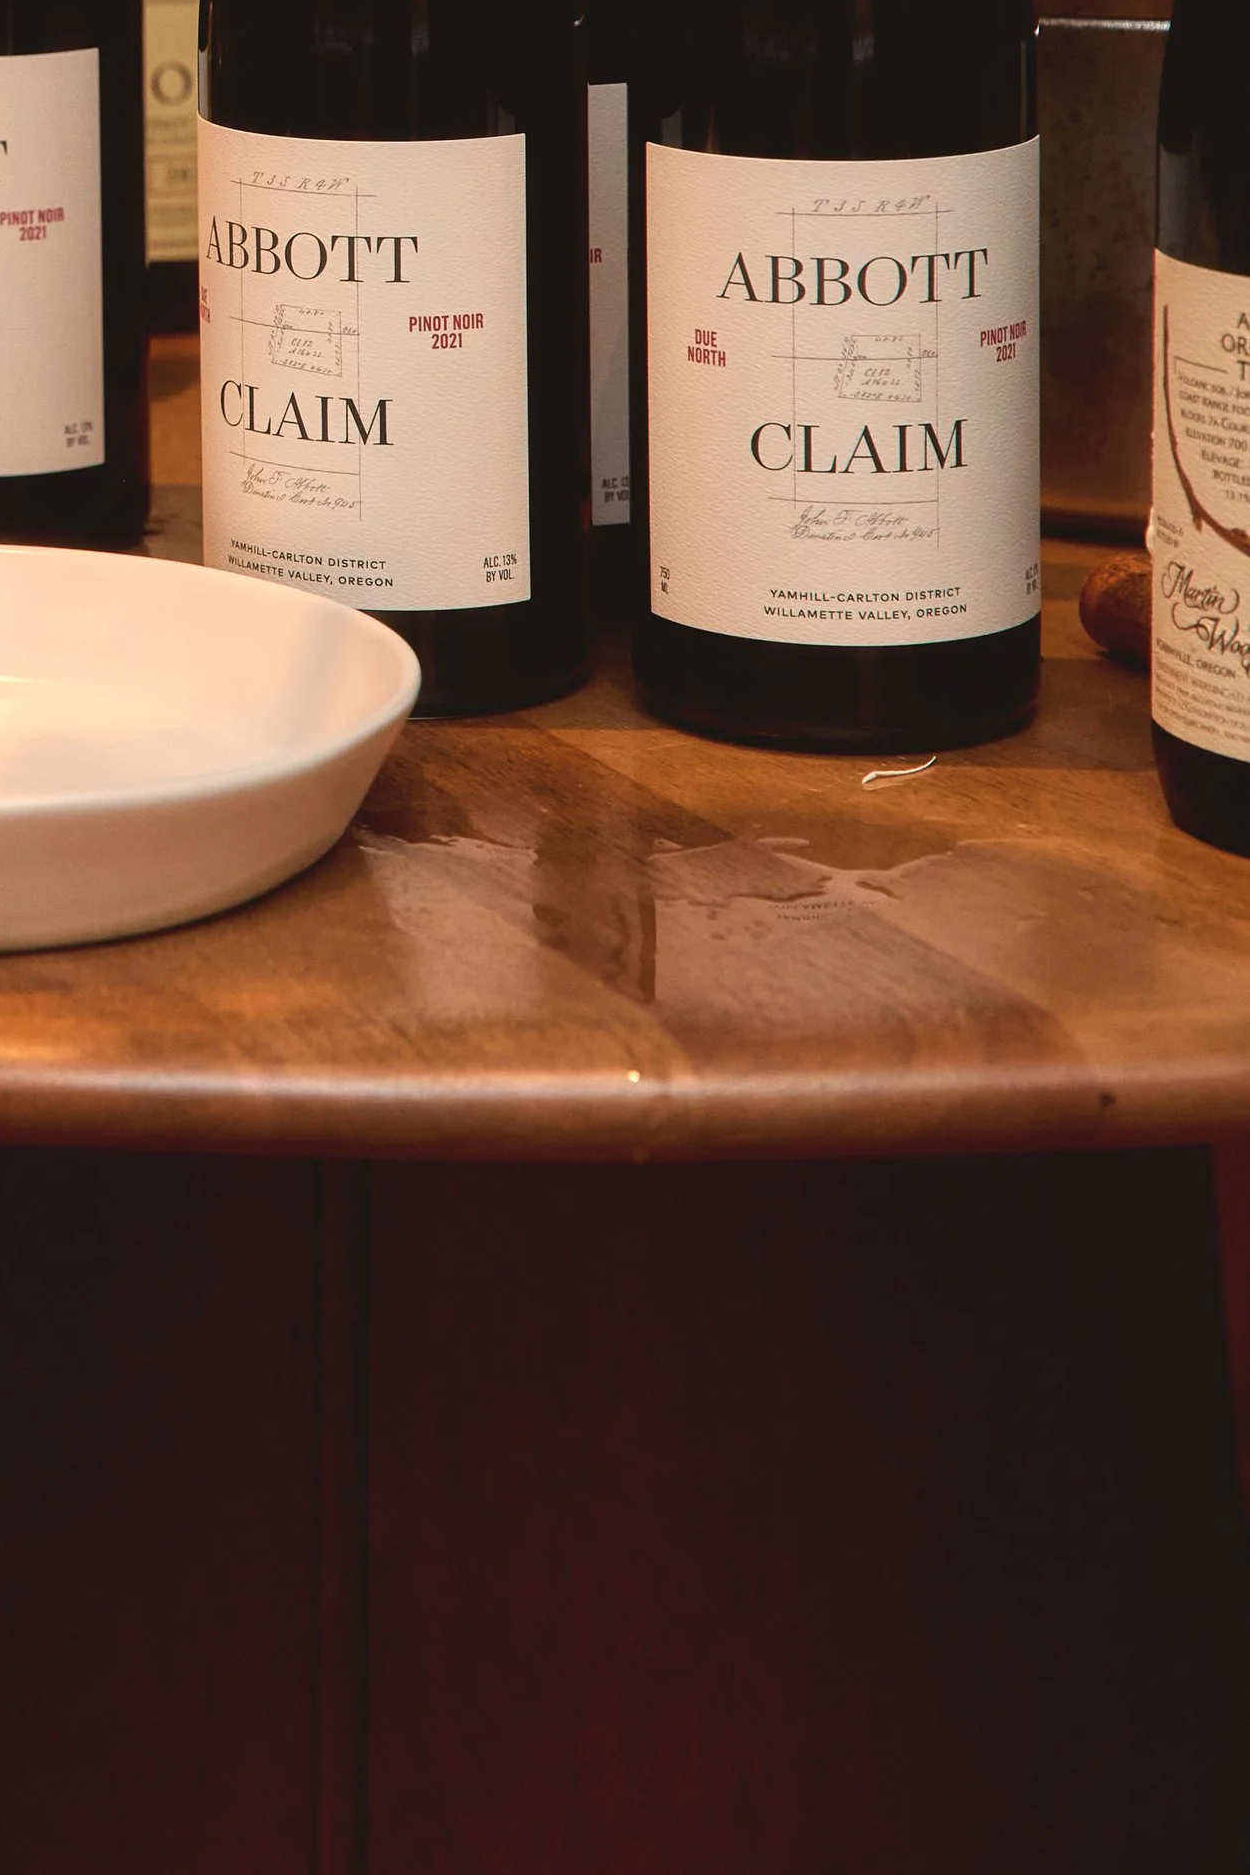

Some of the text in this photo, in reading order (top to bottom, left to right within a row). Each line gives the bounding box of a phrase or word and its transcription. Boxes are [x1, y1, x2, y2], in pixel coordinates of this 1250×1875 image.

[0, 207, 65, 226] PINOT NOIR
[19, 225, 47, 241] 2021
[206, 215, 419, 284] ABBOTT
[717, 247, 989, 307] ABBOTT
[409, 313, 484, 332] PINOT NOIR
[432, 333, 462, 349] 2021
[695, 329, 717, 347] DUE
[981, 320, 1026, 347] PINOT NOIR
[688, 346, 726, 367] NORTH
[997, 342, 1015, 362] 2021
[219, 380, 394, 445] CLAIM
[750, 418, 968, 475] CLAIM
[230, 539, 386, 570] YAMHILL-CARLTON DISTRICT
[484, 553, 518, 569] ALC. 13%
[227, 555, 394, 587] WILLAMETTE VALLEY, OREGON
[486, 569, 515, 583] BY VOL.
[660, 566, 670, 580] 750
[770, 587, 961, 603] YAMHILL-CARLTON DISTRICT
[1162, 561, 1240, 614] Martin
[764, 604, 967, 620] WILLAMETTE VALLEY, OREGON
